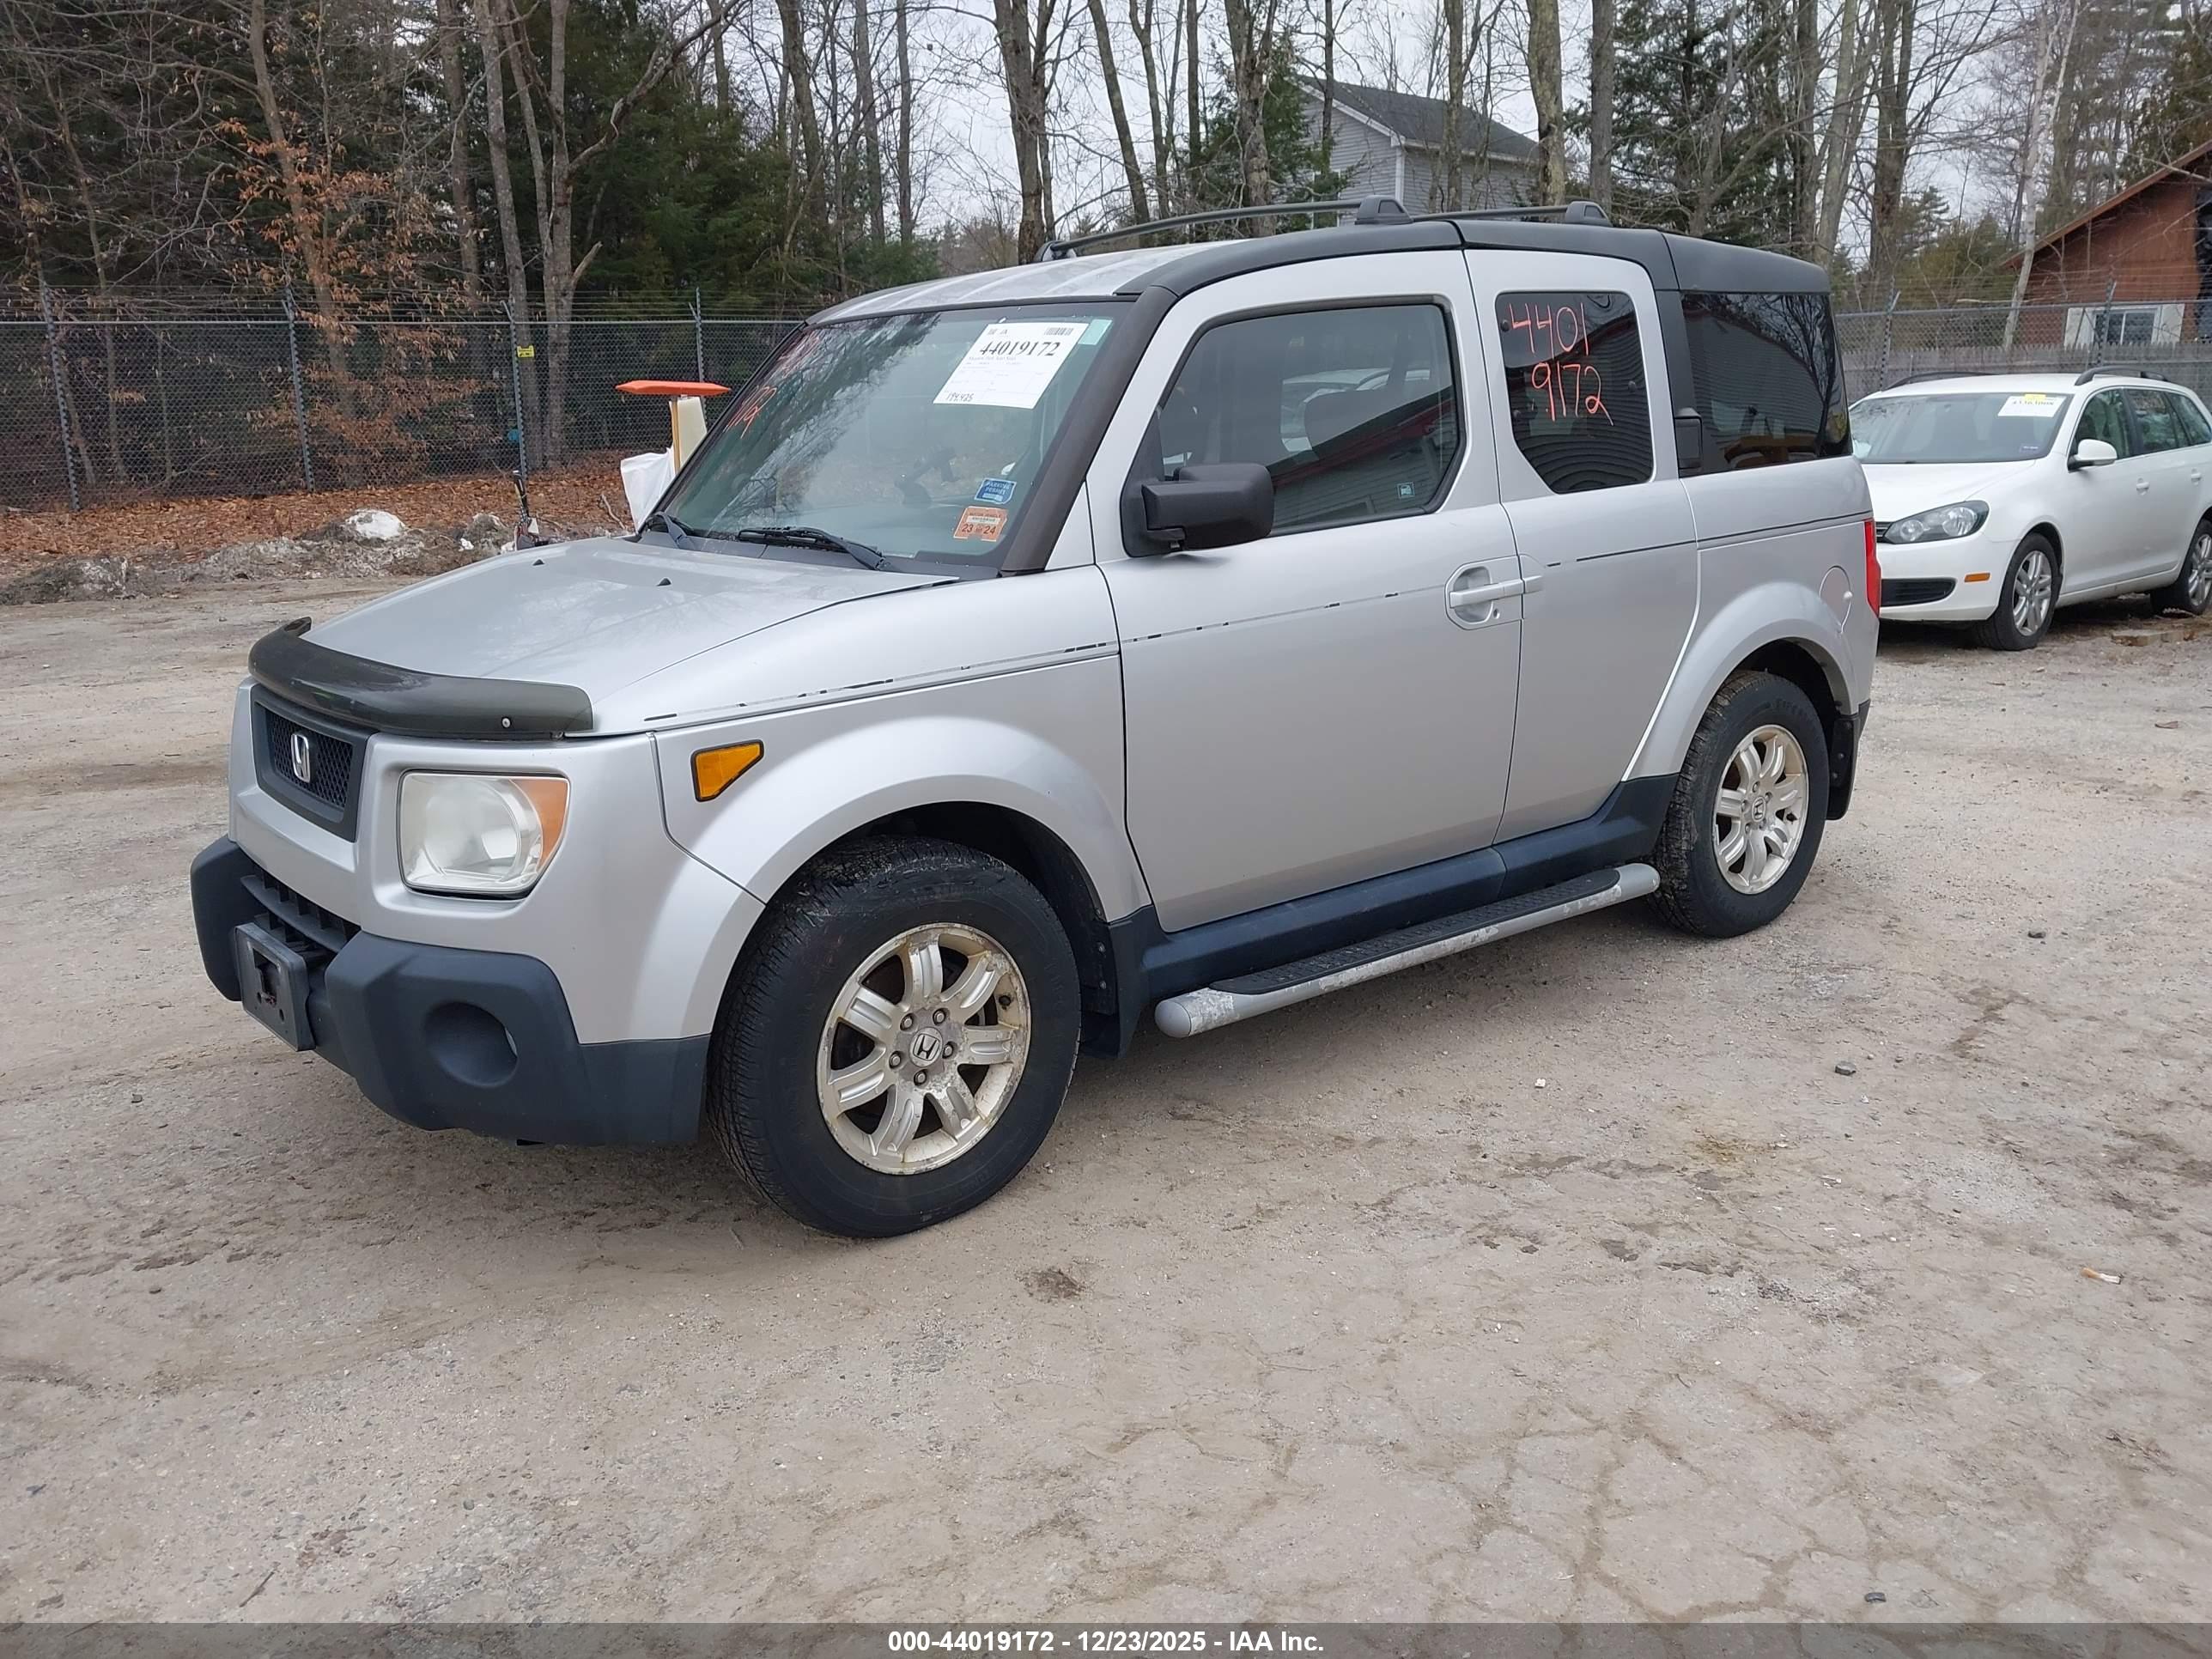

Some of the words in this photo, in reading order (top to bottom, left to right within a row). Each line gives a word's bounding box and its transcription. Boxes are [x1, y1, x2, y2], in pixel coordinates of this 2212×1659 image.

[979, 341, 1061, 356] 44019172
[1509, 302, 1589, 360] 4401
[1531, 361, 1614, 426] 9172
[961, 523, 974, 533] 23
[983, 526, 997, 535] 24
